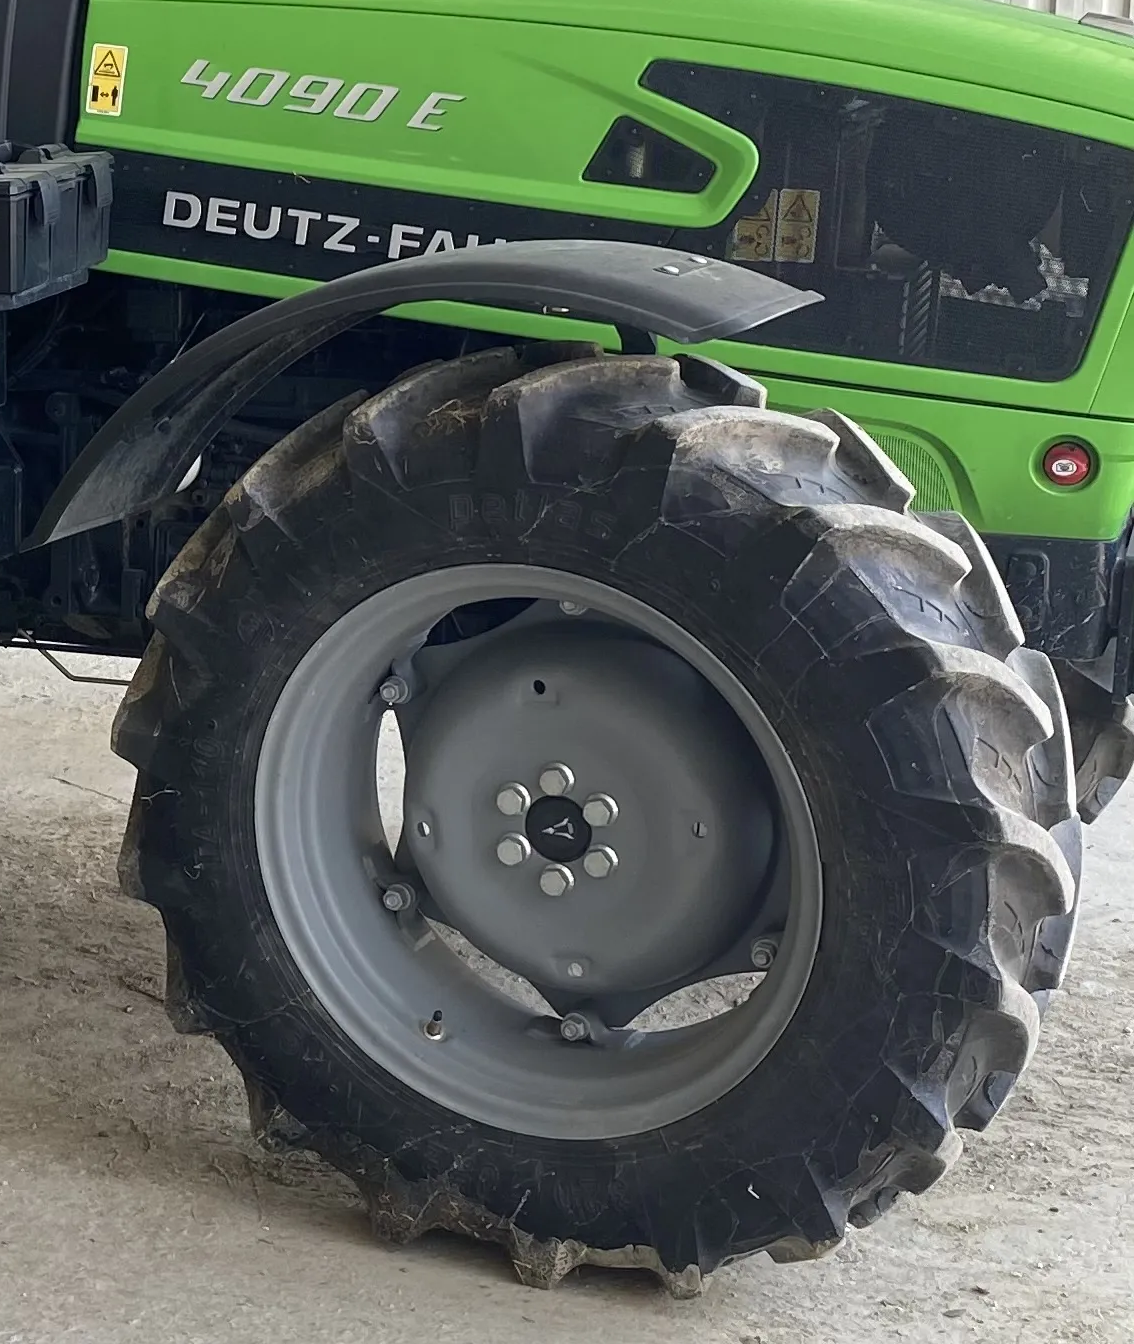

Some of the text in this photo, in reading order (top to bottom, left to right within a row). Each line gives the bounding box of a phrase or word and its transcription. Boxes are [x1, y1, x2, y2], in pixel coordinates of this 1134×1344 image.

[179, 59, 468, 132] 4090 E
[162, 191, 507, 260] DEUTZ-FA
